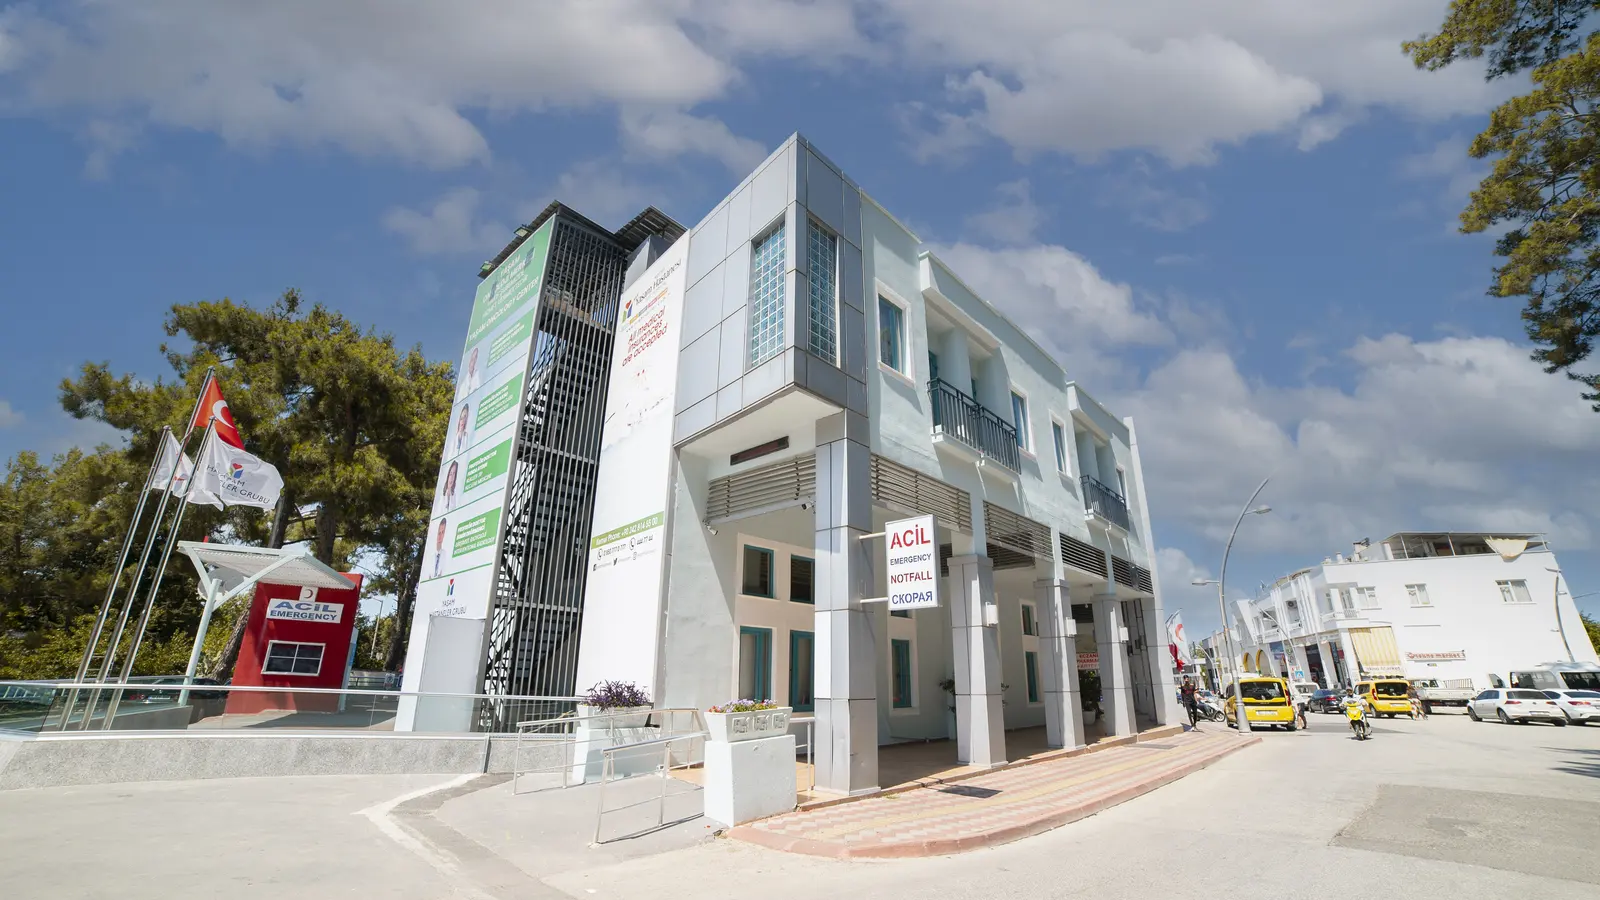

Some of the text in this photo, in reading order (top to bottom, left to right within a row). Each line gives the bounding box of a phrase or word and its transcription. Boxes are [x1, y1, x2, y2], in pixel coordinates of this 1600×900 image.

[515, 275, 539, 301] CENTER
[628, 329, 637, 345] All
[637, 305, 666, 337] medical
[628, 319, 663, 354] insurances
[622, 353, 633, 367] are
[239, 489, 270, 504] GRUBU
[890, 524, 931, 550] ACİL
[890, 553, 932, 566] EMERGENCY
[890, 570, 933, 584] NOTFALL
[891, 591, 933, 605] СКОРАЯ
[270, 610, 338, 621] EMERGENCY
